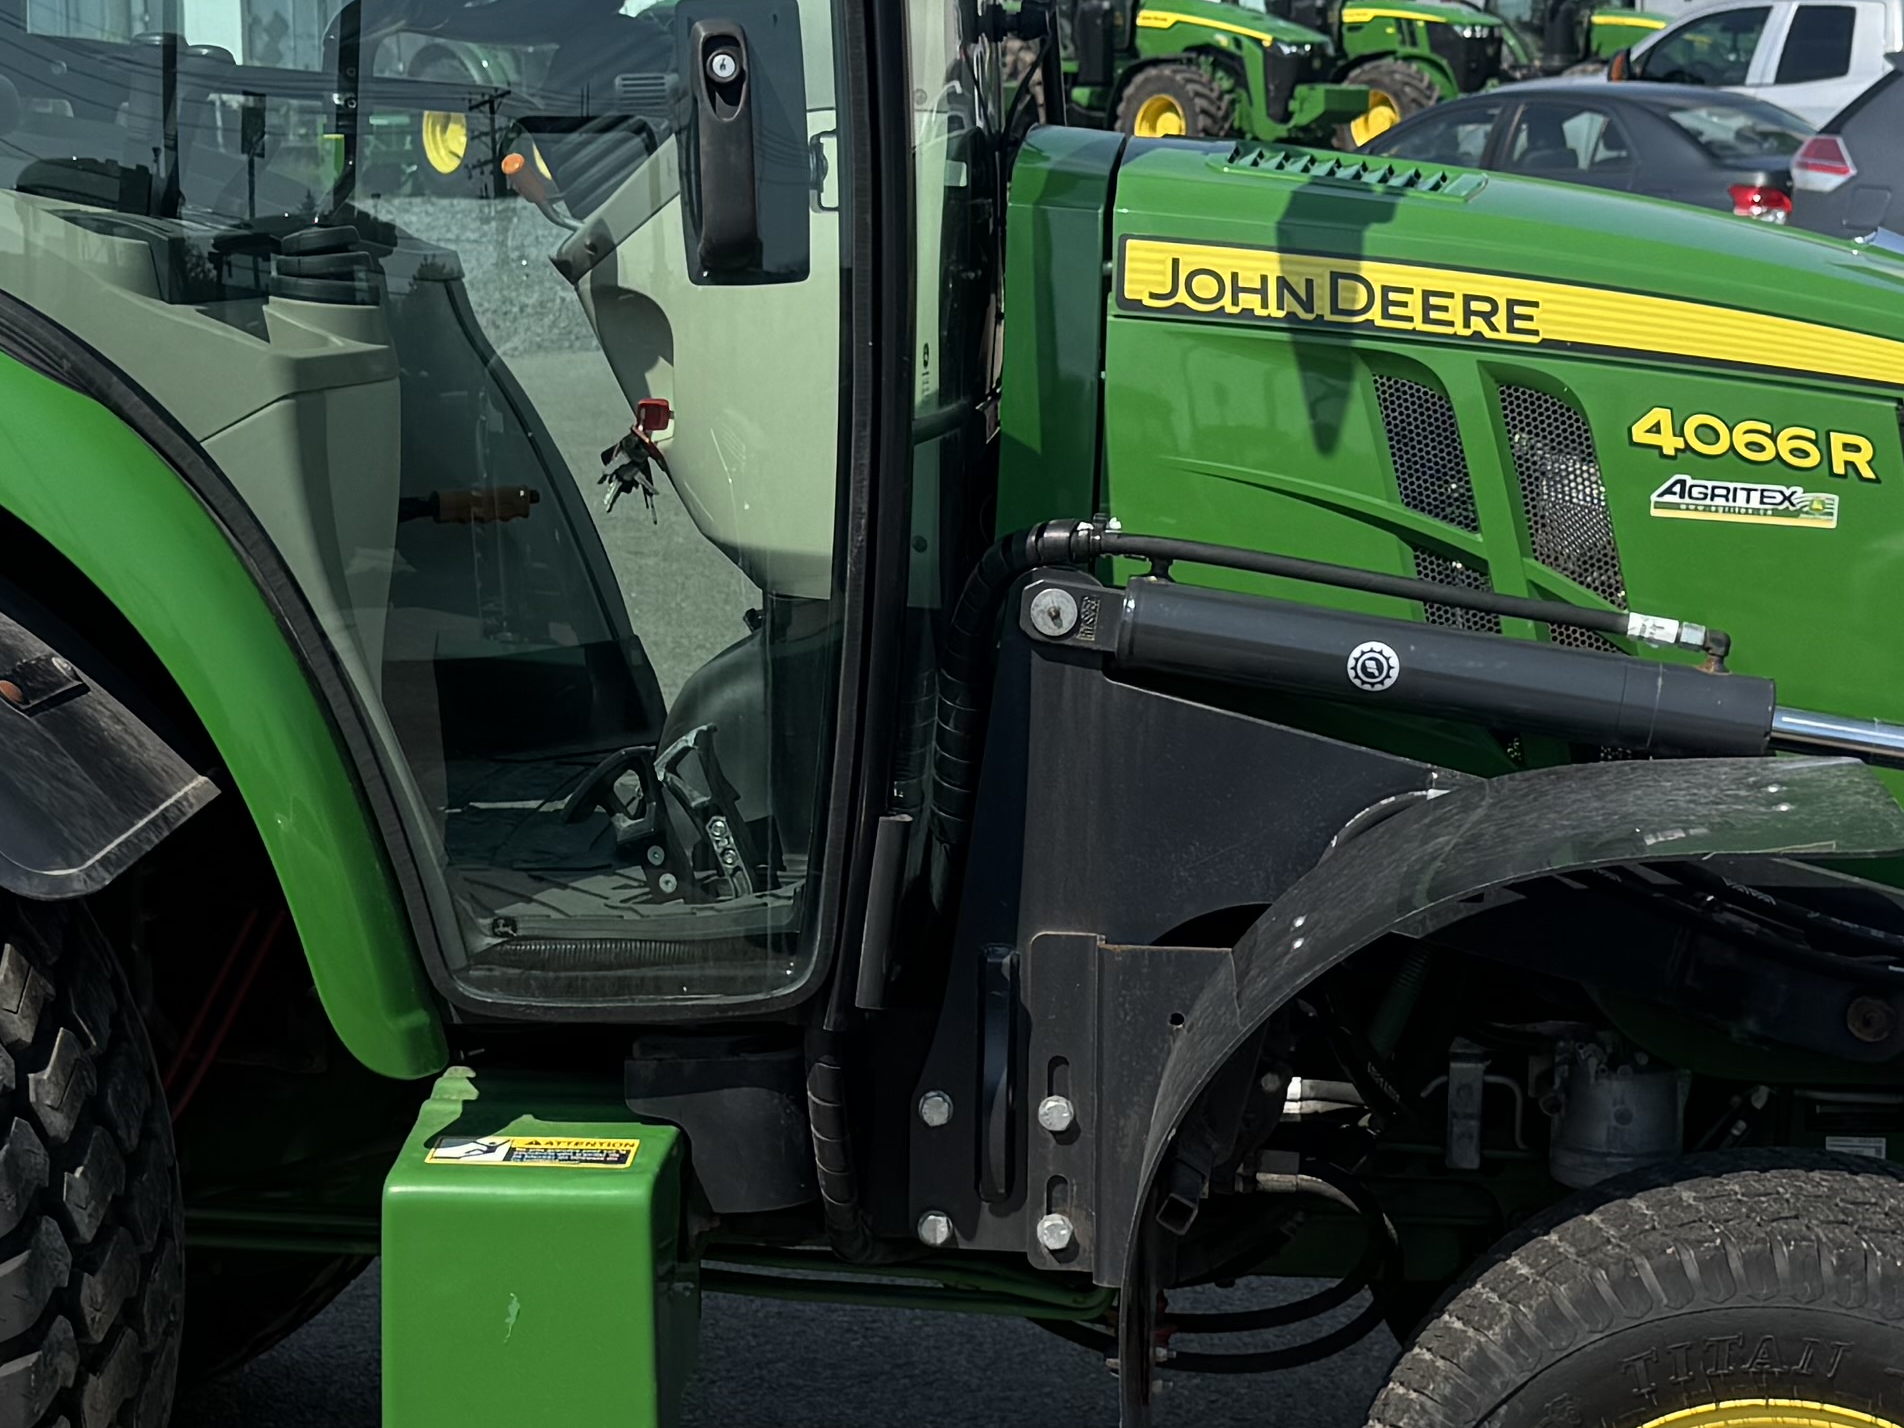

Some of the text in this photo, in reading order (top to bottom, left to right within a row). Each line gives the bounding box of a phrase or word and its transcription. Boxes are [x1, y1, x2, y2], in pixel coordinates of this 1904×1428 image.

[1148, 257, 1541, 336] JOHN DEERE
[1656, 478, 1798, 508] AGRITEX
[545, 1139, 635, 1149] ATTENTION
[1619, 1331, 1856, 1395] TITAN
